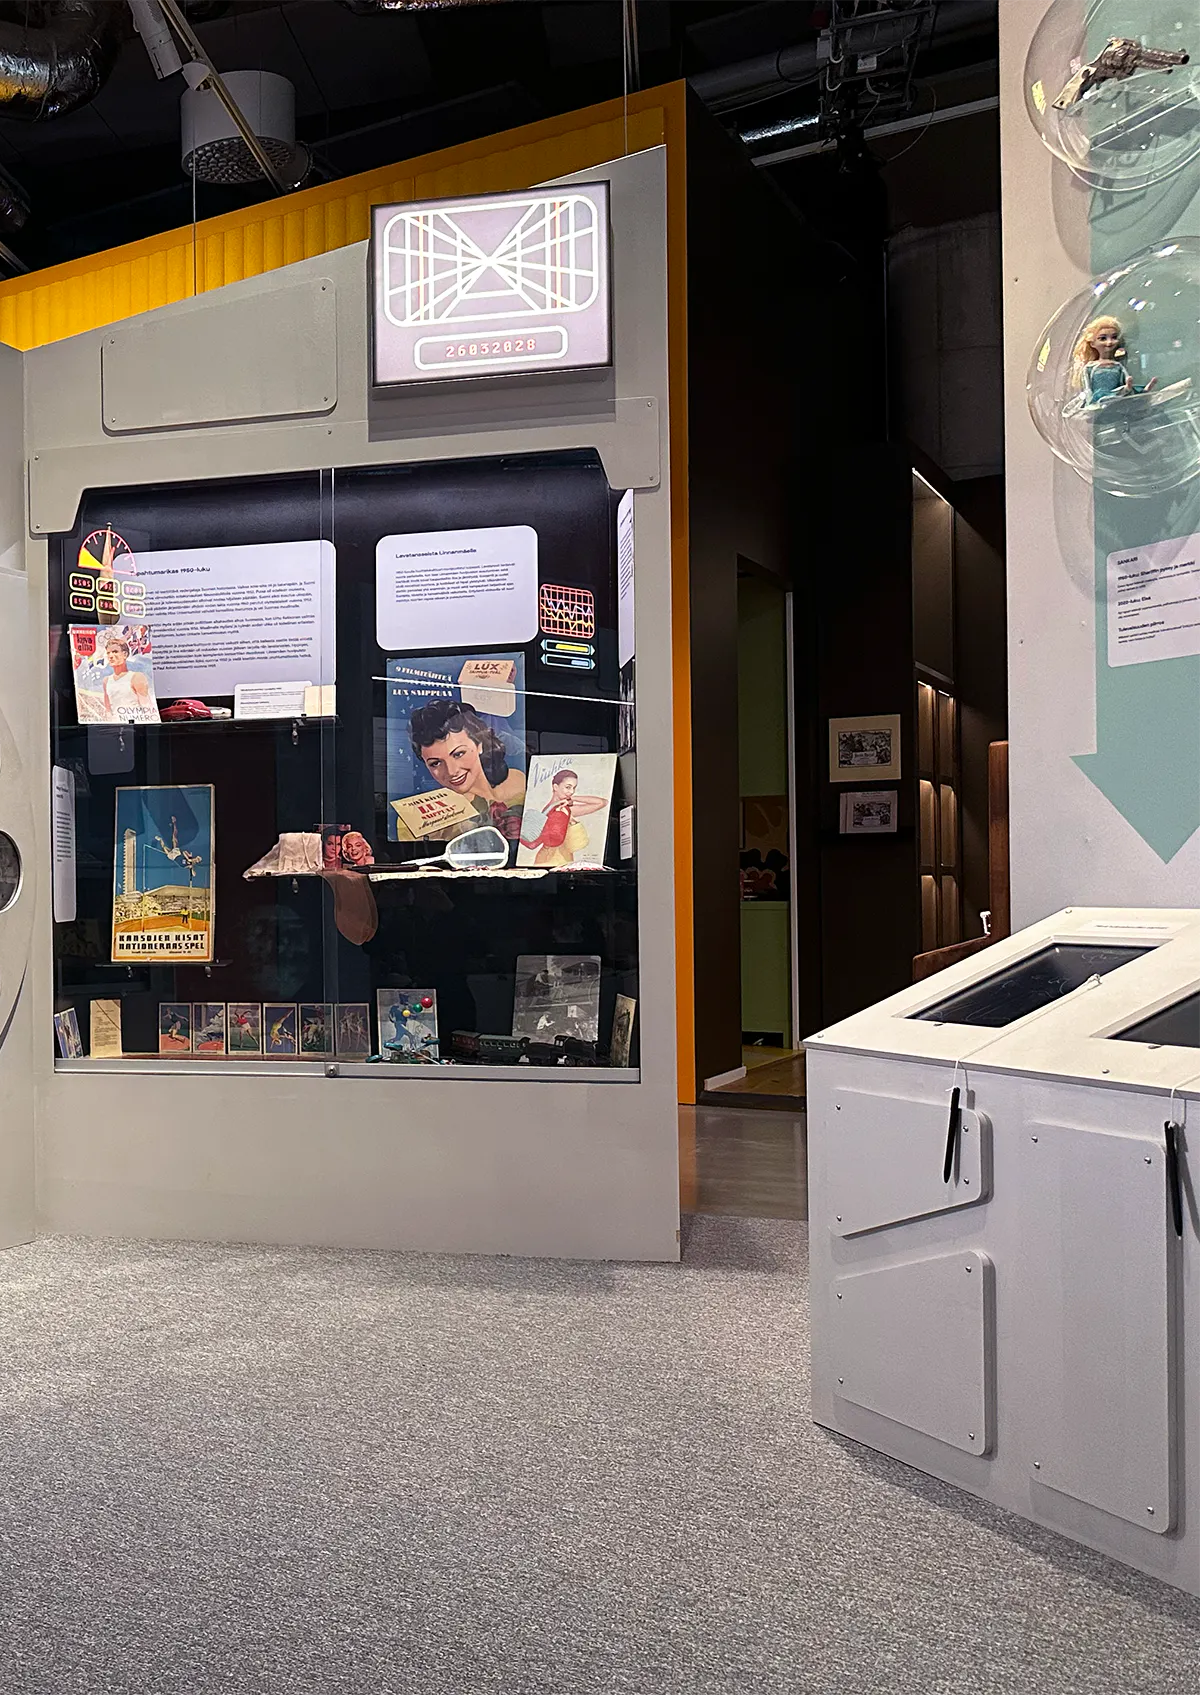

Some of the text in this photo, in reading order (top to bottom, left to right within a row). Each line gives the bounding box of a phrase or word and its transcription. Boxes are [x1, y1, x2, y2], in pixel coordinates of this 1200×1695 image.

[445, 339, 536, 358] 26032028
[402, 667, 453, 682] FILMITÄHTEÄ
[410, 689, 453, 697] SAIPPUAA
[117, 706, 158, 715] OLYMPIA
[417, 800, 449, 814] LUX
[119, 934, 170, 942] KANSOJEN
[119, 942, 183, 950] NATIONERNAS
